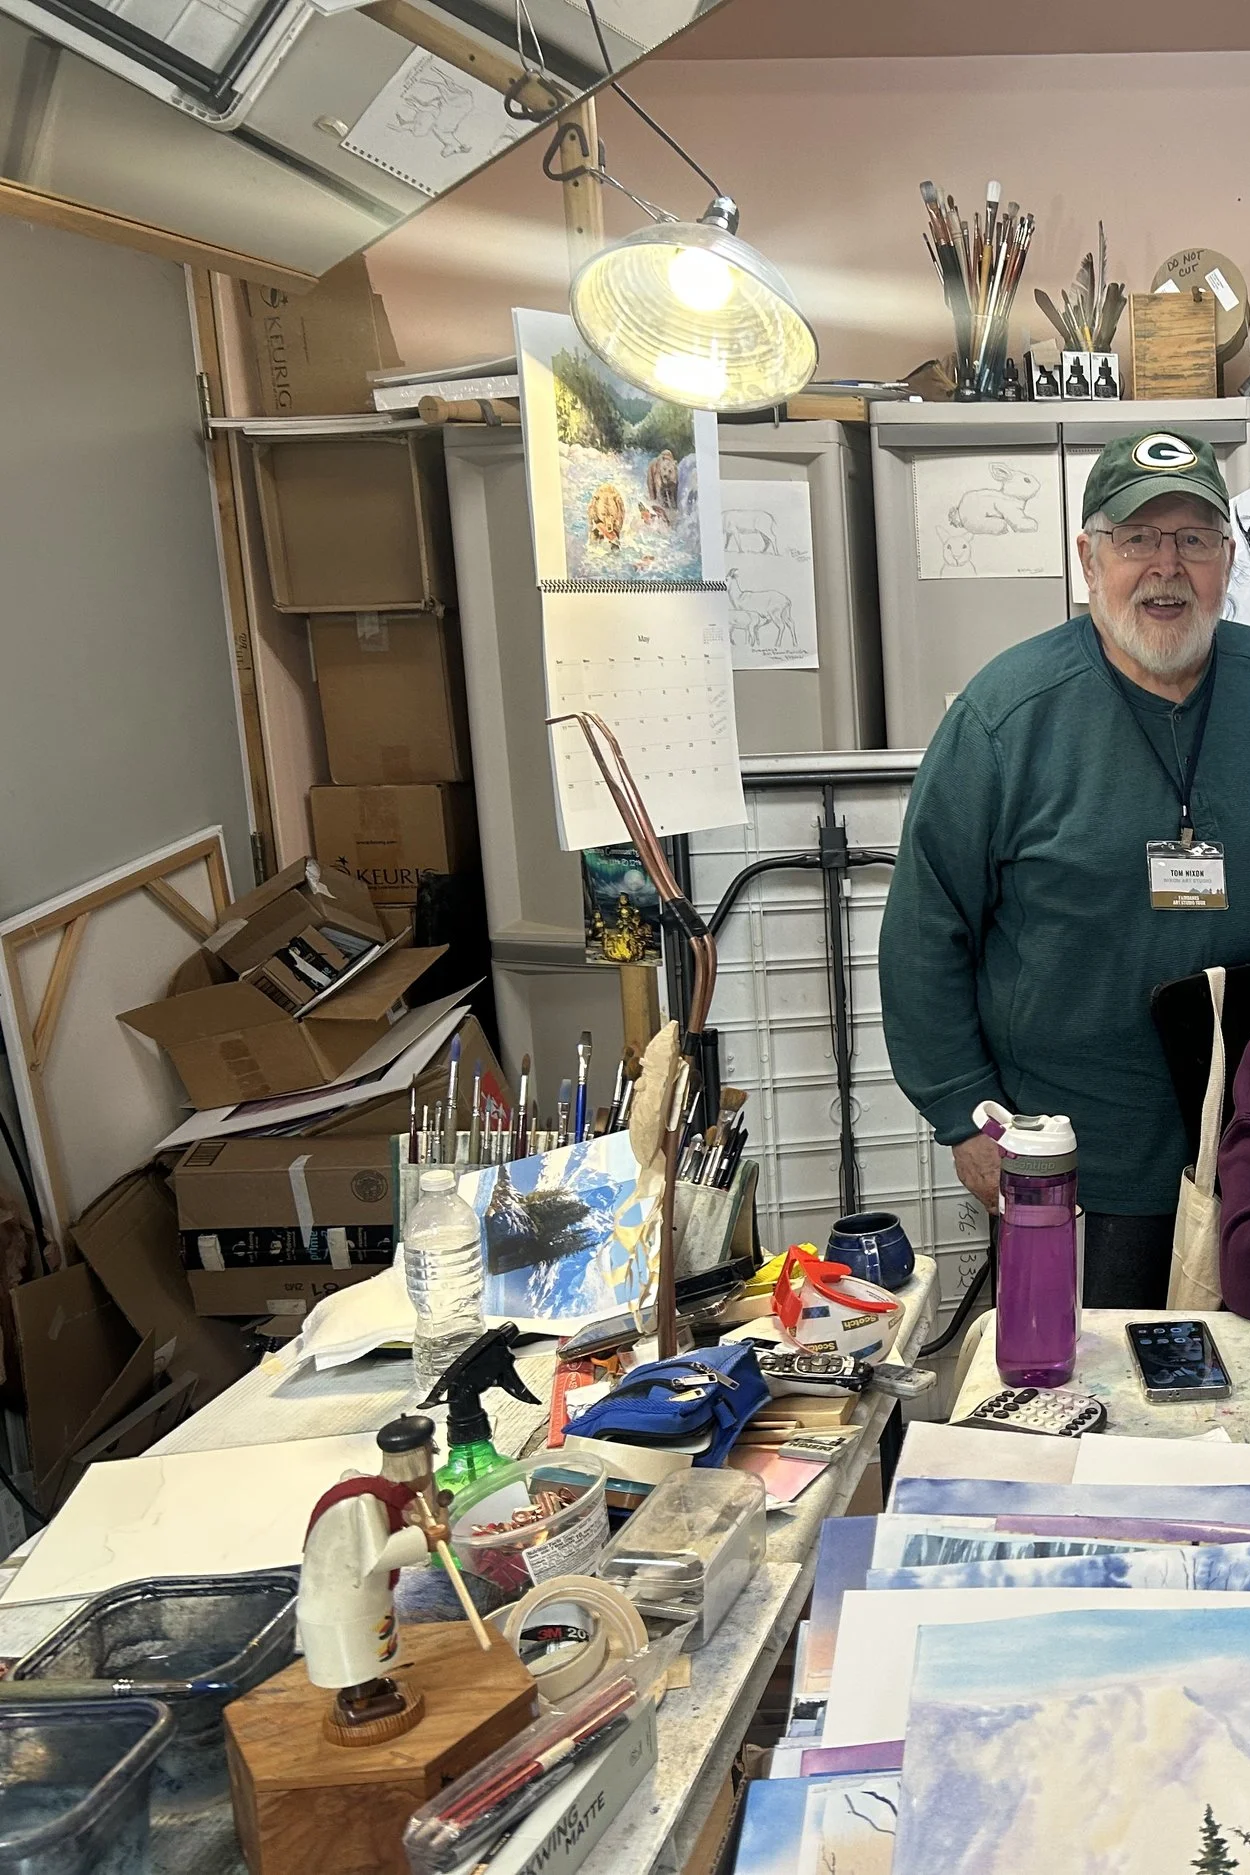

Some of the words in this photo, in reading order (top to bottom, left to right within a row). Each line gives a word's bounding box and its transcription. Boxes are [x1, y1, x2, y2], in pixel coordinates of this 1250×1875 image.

[1167, 259, 1179, 272] DO
[1183, 250, 1205, 264] NOT
[1179, 263, 1199, 277] CUT
[267, 316, 293, 410] KEURIG
[356, 868, 439, 885] KEURI
[1170, 869, 1184, 877] TOM
[310, 1230, 320, 1261] prime
[843, 1315, 877, 1330] Scotch
[805, 1342, 836, 1352] Scotc
[537, 1628, 562, 1640] 3M
[565, 1790, 606, 1855] MATTE
[520, 1803, 580, 1875] KWING
